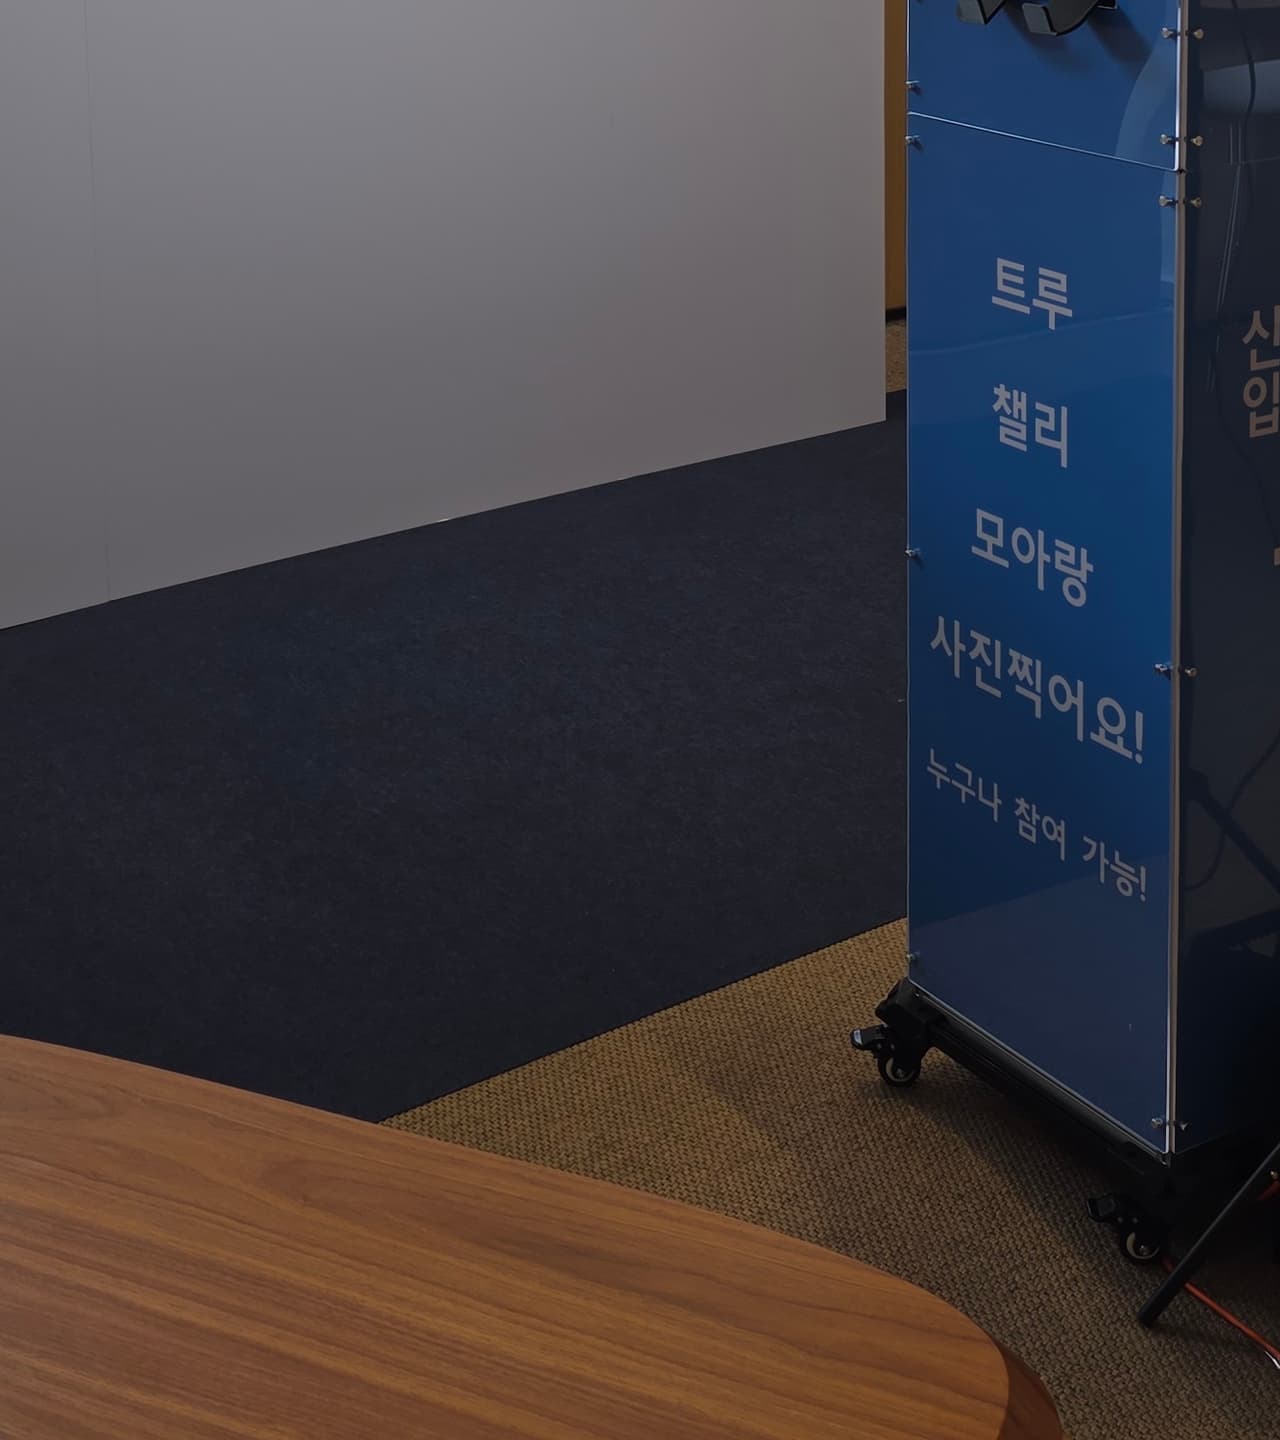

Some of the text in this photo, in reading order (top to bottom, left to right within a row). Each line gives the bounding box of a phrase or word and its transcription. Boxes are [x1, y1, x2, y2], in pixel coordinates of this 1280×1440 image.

[991, 256, 1073, 331] 트루
[991, 383, 1069, 469] 챌리
[970, 507, 1094, 608] 모아랑
[929, 615, 1144, 765] 사진찍어요!
[926, 747, 1147, 903] 누구나 참여 가능!
